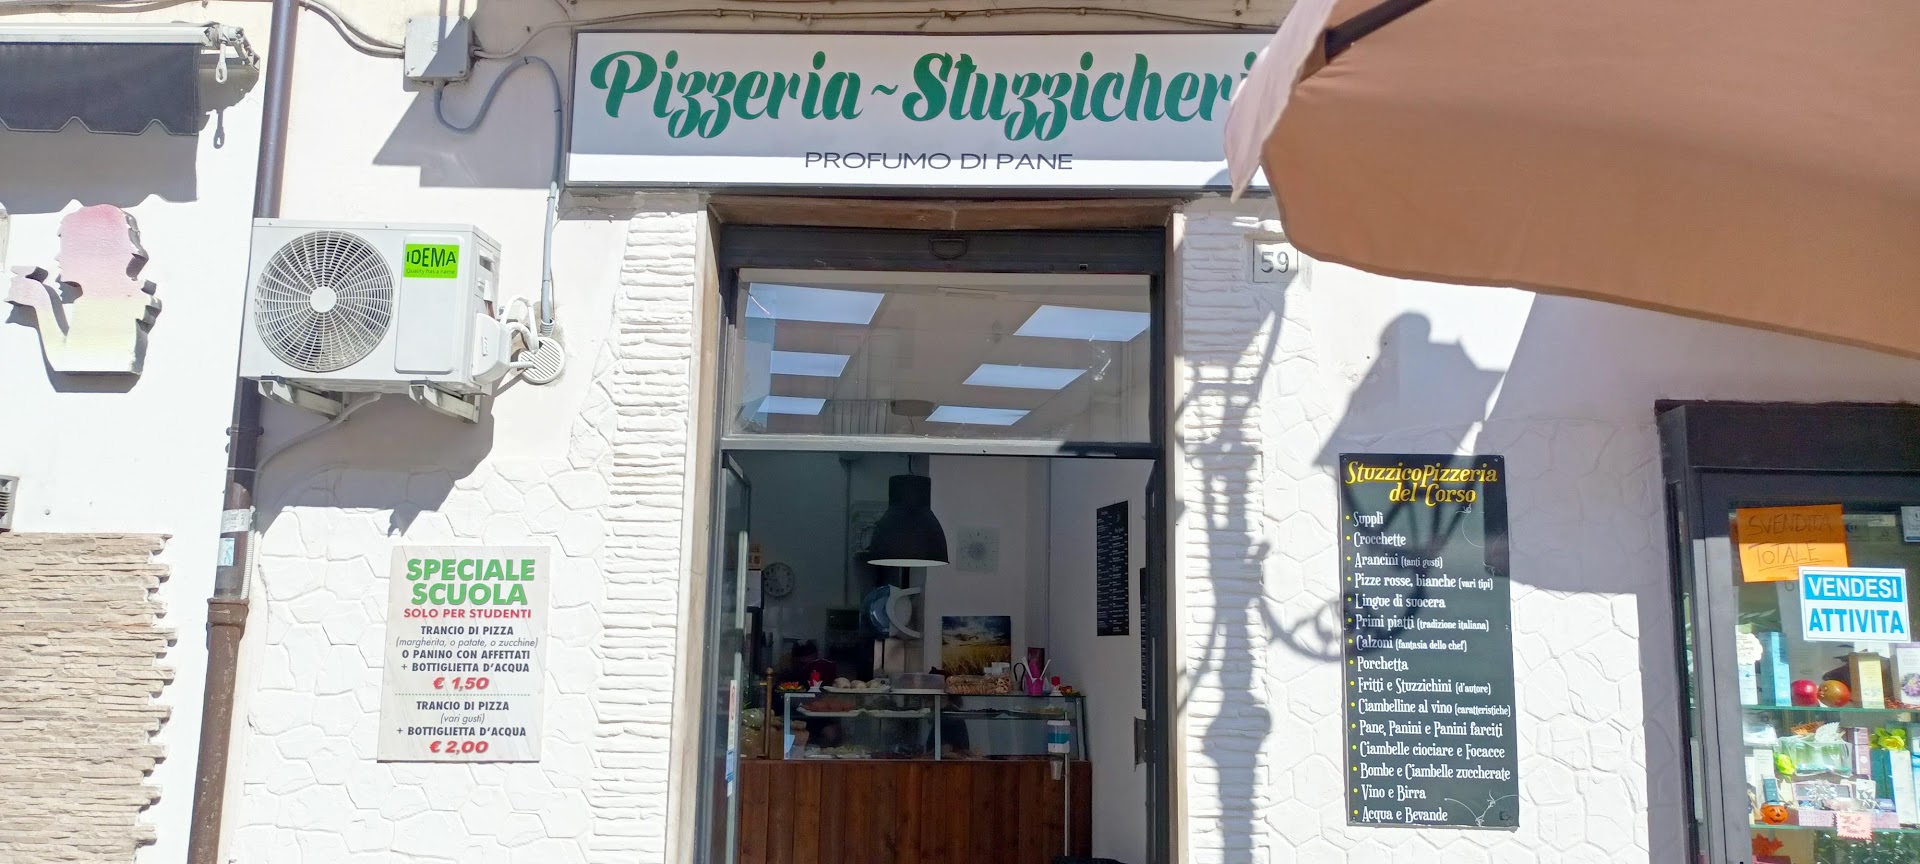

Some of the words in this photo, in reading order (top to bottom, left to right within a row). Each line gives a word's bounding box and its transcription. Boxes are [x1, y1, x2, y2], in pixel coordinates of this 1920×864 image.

[590, 50, 863, 139] Pizzeria
[901, 51, 1257, 141] Stuzzicher
[805, 151, 951, 169] PROFUMO
[959, 152, 989, 169] DI
[997, 152, 1073, 170] PANE
[1261, 251, 1290, 273] 59
[1389, 481, 1416, 502] del
[1424, 482, 1477, 507] Corso
[1747, 512, 1834, 536] SVENDITA
[1354, 532, 1406, 547] Crocchette
[1354, 553, 1399, 568] Arancini
[1400, 556, 1422, 569] (tanti
[1423, 556, 1443, 569] gusti)
[1747, 542, 1821, 565] TOTALE
[405, 558, 535, 581] SPECIALE
[1354, 574, 1382, 589] Pizze
[1384, 576, 1414, 589] rosse,
[1415, 574, 1456, 589] bianche
[1458, 576, 1476, 590] (vari
[1477, 577, 1494, 591] tipi)
[1807, 577, 1898, 599] VENDESI
[411, 583, 528, 606] SCUOLA
[1355, 594, 1390, 611] Lingue
[1393, 595, 1403, 608] di
[1406, 597, 1446, 609] suocera
[403, 608, 439, 618] SOLO
[442, 609, 465, 618] PER
[469, 609, 532, 619] STUDENTI
[1809, 608, 1905, 634] ATTIVITA
[421, 626, 465, 635] TRANCIO
[468, 626, 479, 635] DI
[482, 626, 514, 636] PIZZA
[1355, 615, 1385, 630] Primi
[1387, 615, 1415, 632] piatti
[1416, 618, 1457, 631] (tradizione
[1458, 618, 1489, 632] italiana)
[396, 637, 447, 648] (margherita,
[457, 638, 486, 649] patate,
[498, 638, 539, 648] zucchine)
[1355, 635, 1393, 650] Calzoni
[1395, 638, 1428, 652] (fantasia
[1429, 639, 1447, 650] dello
[1448, 639, 1467, 653] chef)
[402, 650, 409, 659] O
[413, 650, 453, 659] PANINO
[456, 650, 478, 659] CON
[481, 650, 530, 659] AFFETTATI
[412, 663, 479, 672] BOTTIGLIETTA
[483, 663, 530, 674] D'ACQUA
[1357, 657, 1409, 672] Porchetta
[432, 677, 445, 689] €
[451, 677, 489, 691] 1,50
[1358, 678, 1384, 693] Fritti
[1386, 683, 1393, 692] e
[1395, 679, 1452, 693] Stuzzichini
[1455, 681, 1491, 695] (d'autore)
[416, 701, 460, 710] TRANCIO
[464, 701, 475, 711] DI
[478, 701, 510, 711] PIZZA
[1358, 699, 1416, 715] Ciambelline
[1418, 700, 1428, 714] al
[1430, 702, 1453, 715] vino
[1454, 703, 1511, 717] (caratteristiche)
[440, 713, 460, 724] (vari
[462, 713, 485, 725] gusti)
[407, 727, 475, 736] BOTTIGLIETTA
[479, 727, 526, 737] D'ACQUA
[1359, 719, 1386, 737] Pane,
[1388, 720, 1422, 735] Panini
[1425, 725, 1431, 735] e
[1434, 721, 1467, 736] Panini
[1470, 721, 1503, 738] farciti
[429, 741, 441, 753] €
[446, 741, 489, 755] 2,00
[1359, 741, 1410, 757] Ciambelle
[1413, 742, 1454, 757] ciociare
[1456, 747, 1463, 757] e
[1465, 743, 1505, 759] Focacce
[1360, 763, 1394, 779] Bombe
[1396, 768, 1403, 778] e
[1405, 764, 1454, 780] Ciambelle
[1456, 765, 1510, 781] zuccherate
[1361, 784, 1384, 800] Vino
[1387, 790, 1394, 799] e
[1397, 785, 1426, 800] Birra
[1362, 806, 1393, 823] Acqua
[1395, 811, 1402, 821] e
[1405, 806, 1448, 822] Bevande
